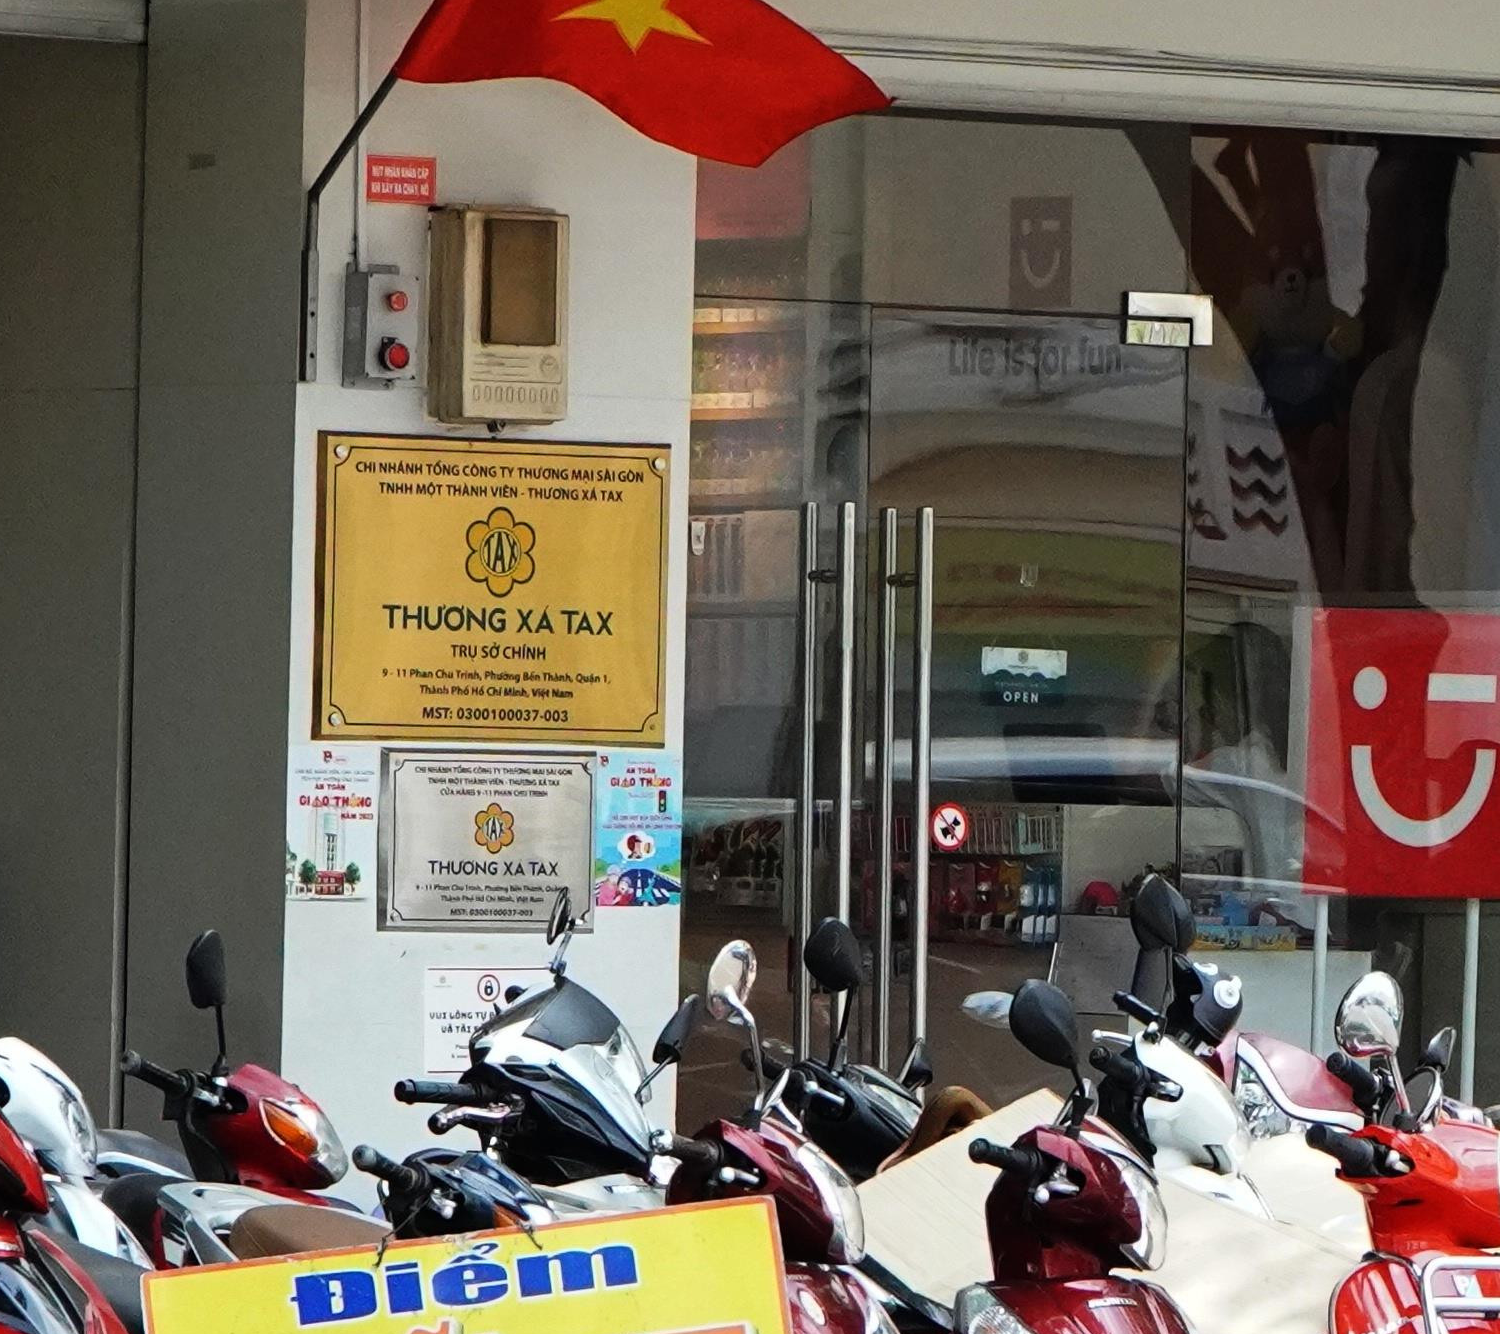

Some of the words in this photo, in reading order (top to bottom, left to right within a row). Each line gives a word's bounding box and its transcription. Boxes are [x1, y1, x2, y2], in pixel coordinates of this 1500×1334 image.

[356, 461, 377, 473] CHI
[379, 461, 423, 475] NHÁNH
[426, 460, 460, 477] TỔNG
[462, 463, 497, 478] CÔNG
[500, 467, 514, 478] TY
[517, 467, 569, 481] THƯƠNG
[571, 469, 595, 485] MẠI
[597, 469, 616, 482] SÀI
[618, 469, 644, 483] GÒN
[379, 481, 413, 495] TNHH
[416, 483, 442, 497] MỘT
[446, 483, 487, 497] THÀNH
[491, 485, 518, 498] VIÊN
[527, 487, 579, 501] THƯƠNG
[582, 488, 598, 501] XÁ
[600, 491, 623, 502] TAX
[382, 603, 506, 634] THƯƠNG
[516, 605, 554, 634] XÁ
[560, 610, 614, 636] TAX
[451, 644, 478, 662] TRỤ
[481, 642, 500, 659] SỞ
[503, 644, 546, 660] CHÍNH
[382, 668, 388, 678] 9
[397, 669, 407, 678] 11
[409, 669, 433, 679] Phan
[435, 669, 453, 679] Chu
[1003, 690, 1039, 703] OPEN
[422, 707, 453, 719] MST:
[457, 708, 568, 722] 0300100037-003
[428, 860, 498, 875] THƯƠNG
[503, 859, 525, 876] XÁ
[528, 862, 558, 876] TAX
[289, 1241, 639, 1326] Điểm
